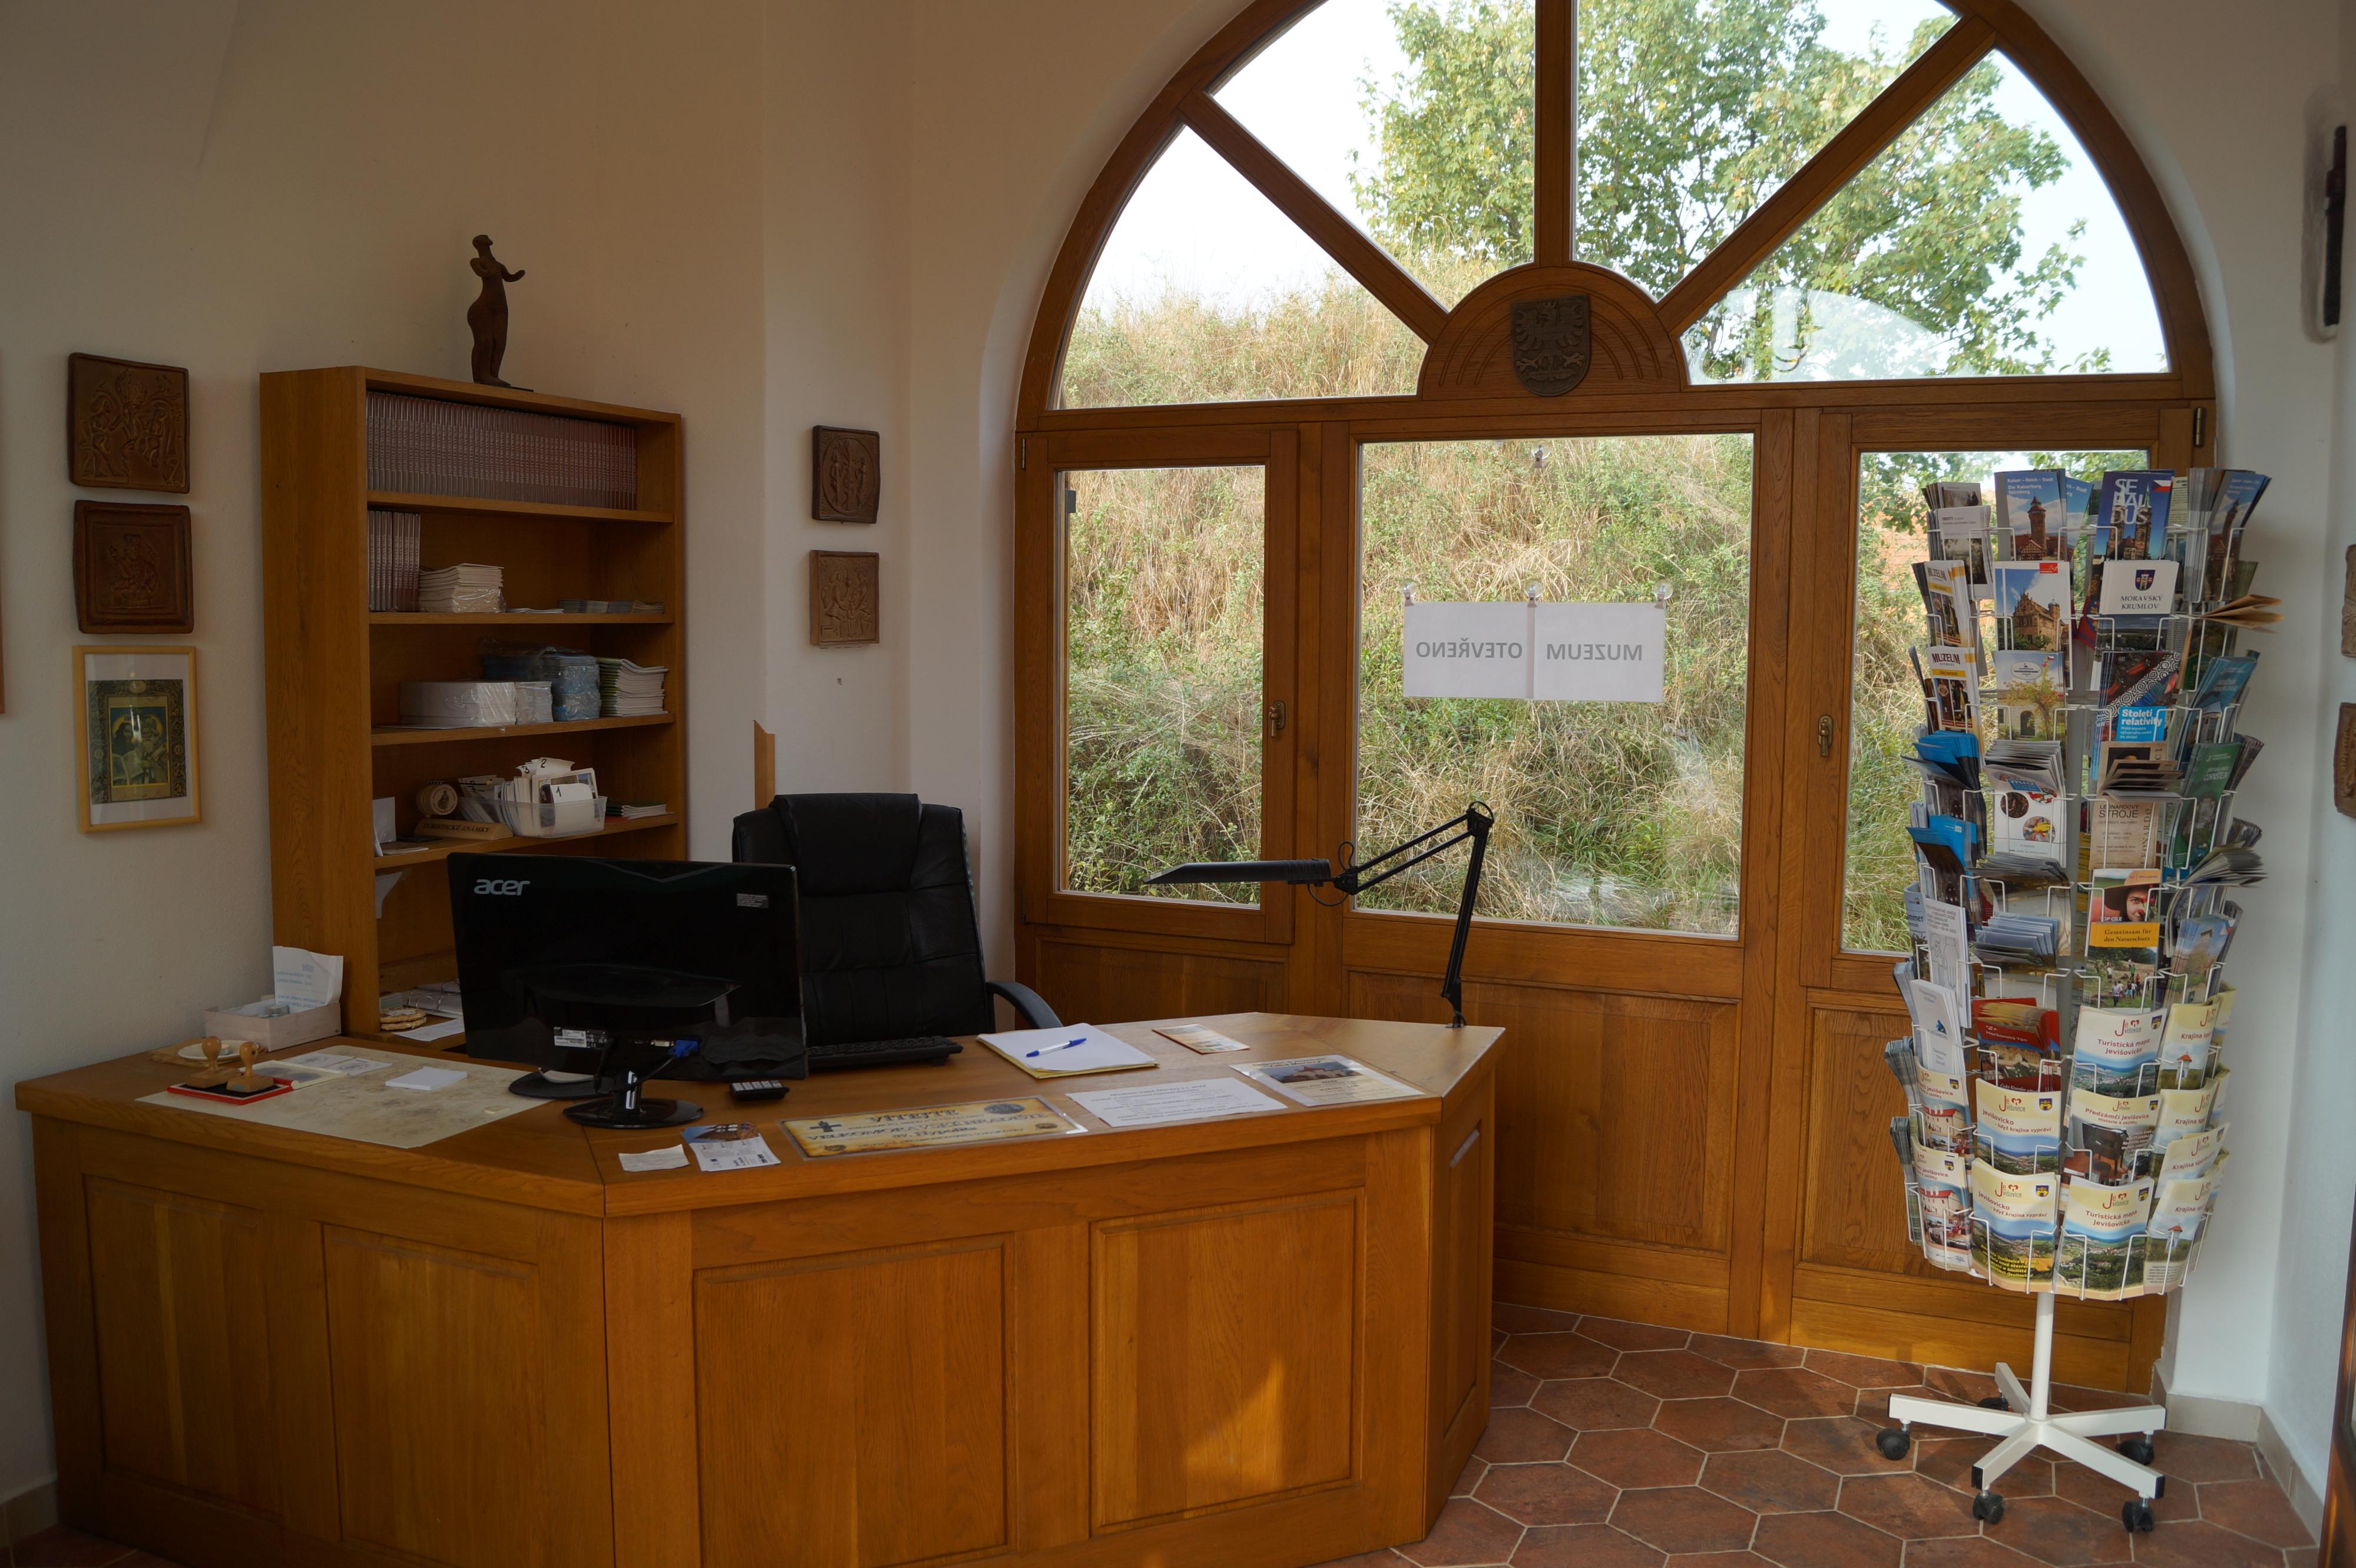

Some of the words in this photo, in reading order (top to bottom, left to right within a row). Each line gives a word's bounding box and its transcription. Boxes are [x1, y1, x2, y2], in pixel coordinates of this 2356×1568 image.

[1932, 653, 1960, 664] MUZEUM
[2122, 717, 2163, 726] relativity
[540, 759, 547, 768] 2
[522, 766, 530, 774] 3
[556, 786, 562, 797] 1
[2099, 810, 2139, 818] STROJE
[474, 879, 531, 896] acer
[2097, 1038, 2134, 1048] Turistická
[1927, 1086, 1954, 1096] Jevišovice
[869, 1109, 959, 1123] VÍTEJTE
[1983, 1109, 2014, 1125] Jevišovicko
[2085, 1107, 2120, 1120] Předzámčí
[1922, 1168, 1948, 1177] Jevišovice
[1978, 1191, 2010, 1210] Jevišovicko
[2086, 1210, 2121, 1220] Turistická
